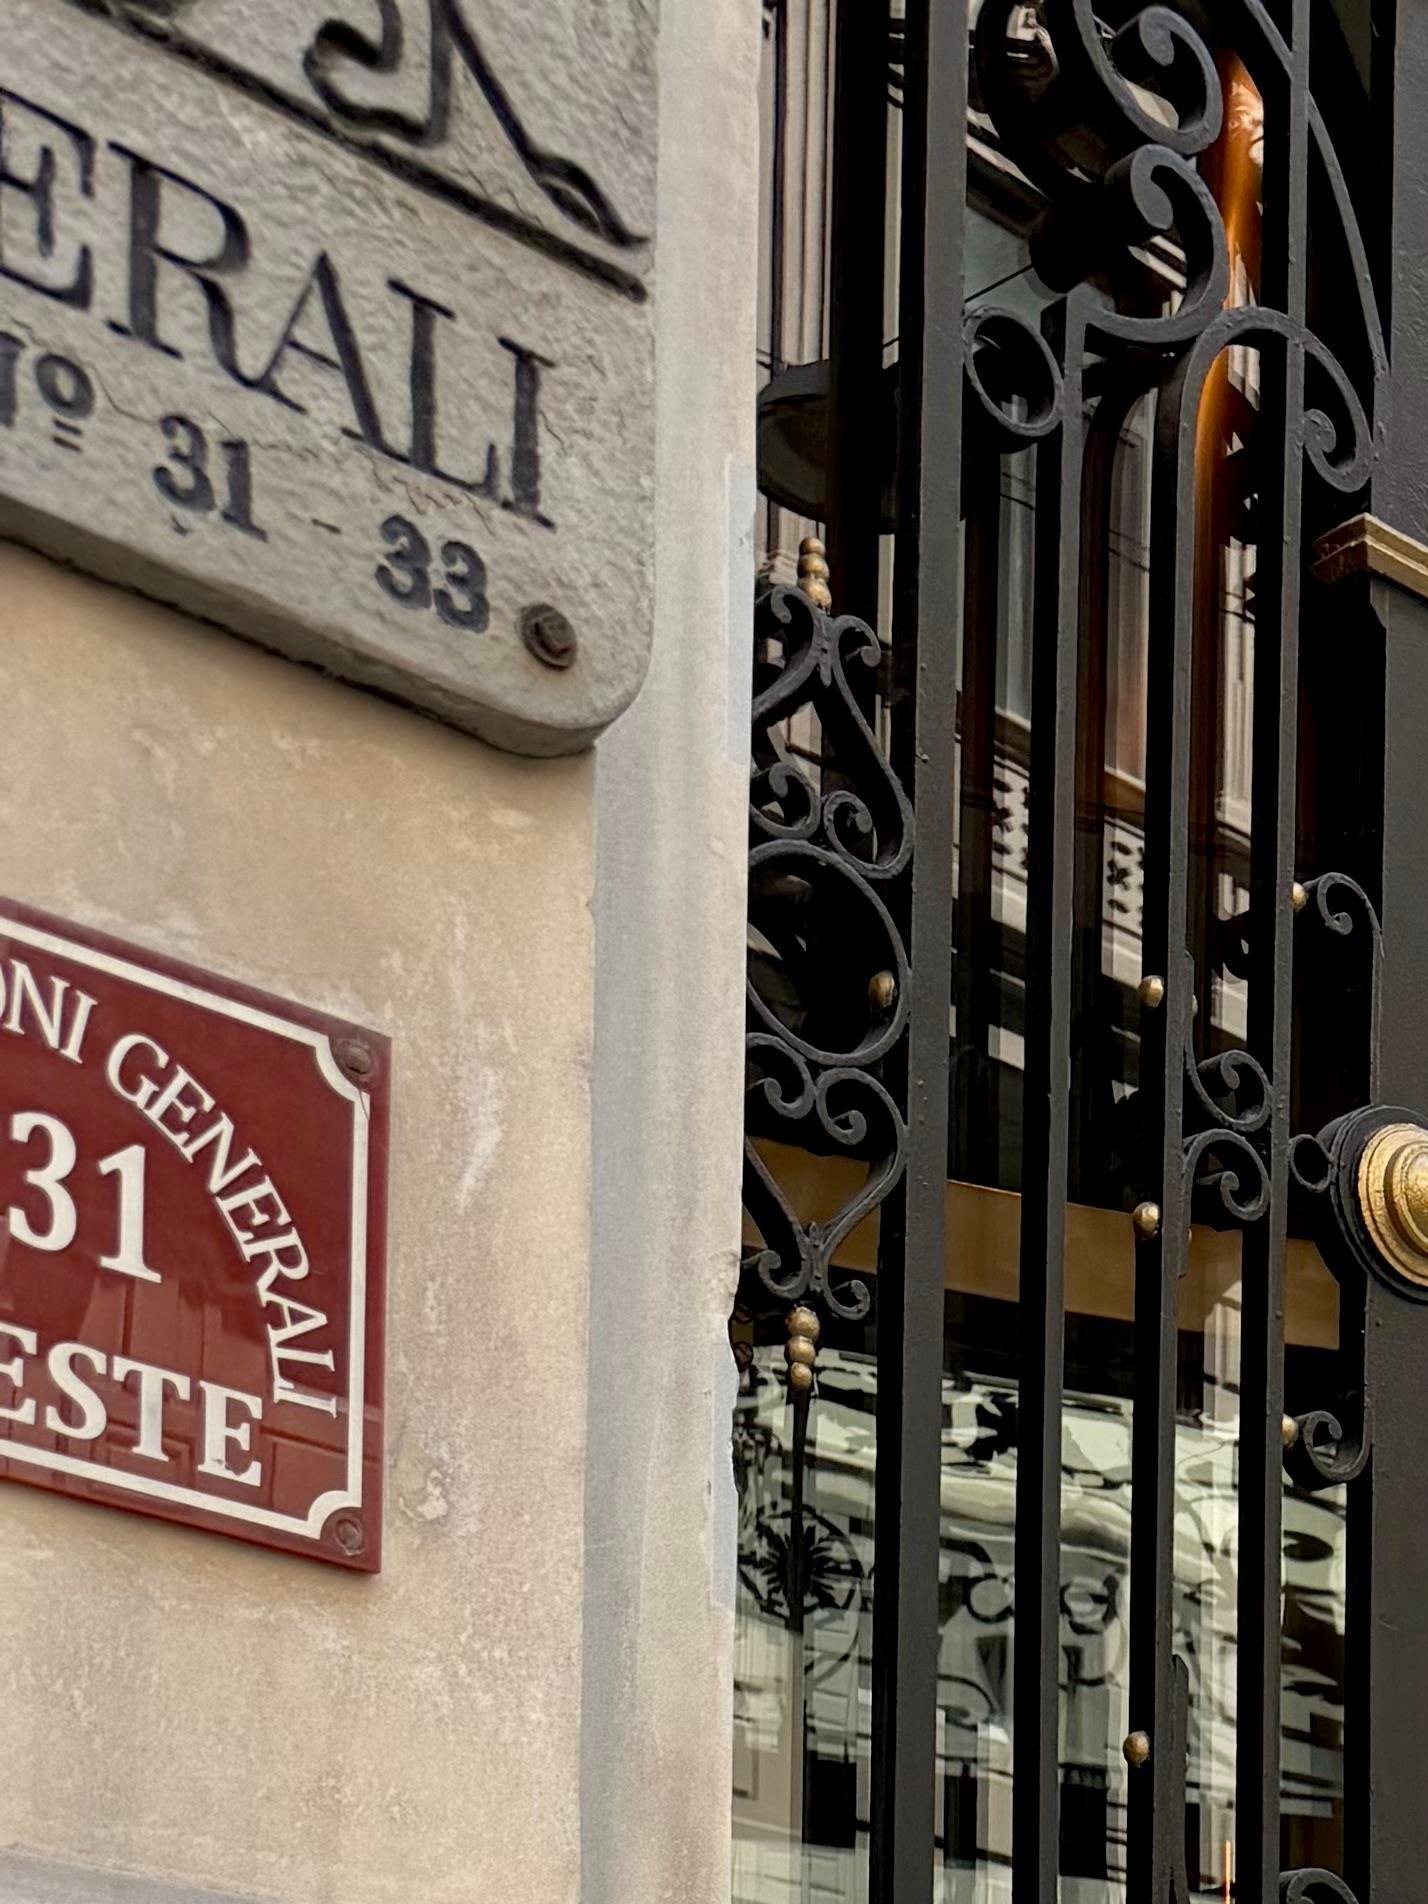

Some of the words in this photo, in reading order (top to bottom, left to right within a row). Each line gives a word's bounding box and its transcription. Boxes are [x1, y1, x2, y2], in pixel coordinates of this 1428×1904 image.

[153, 413, 268, 542] 31
[374, 514, 490, 633] 33
[0, 958, 98, 1064] NI
[105, 1032, 338, 1420] GENERALI
[9, 1110, 162, 1282] 31
